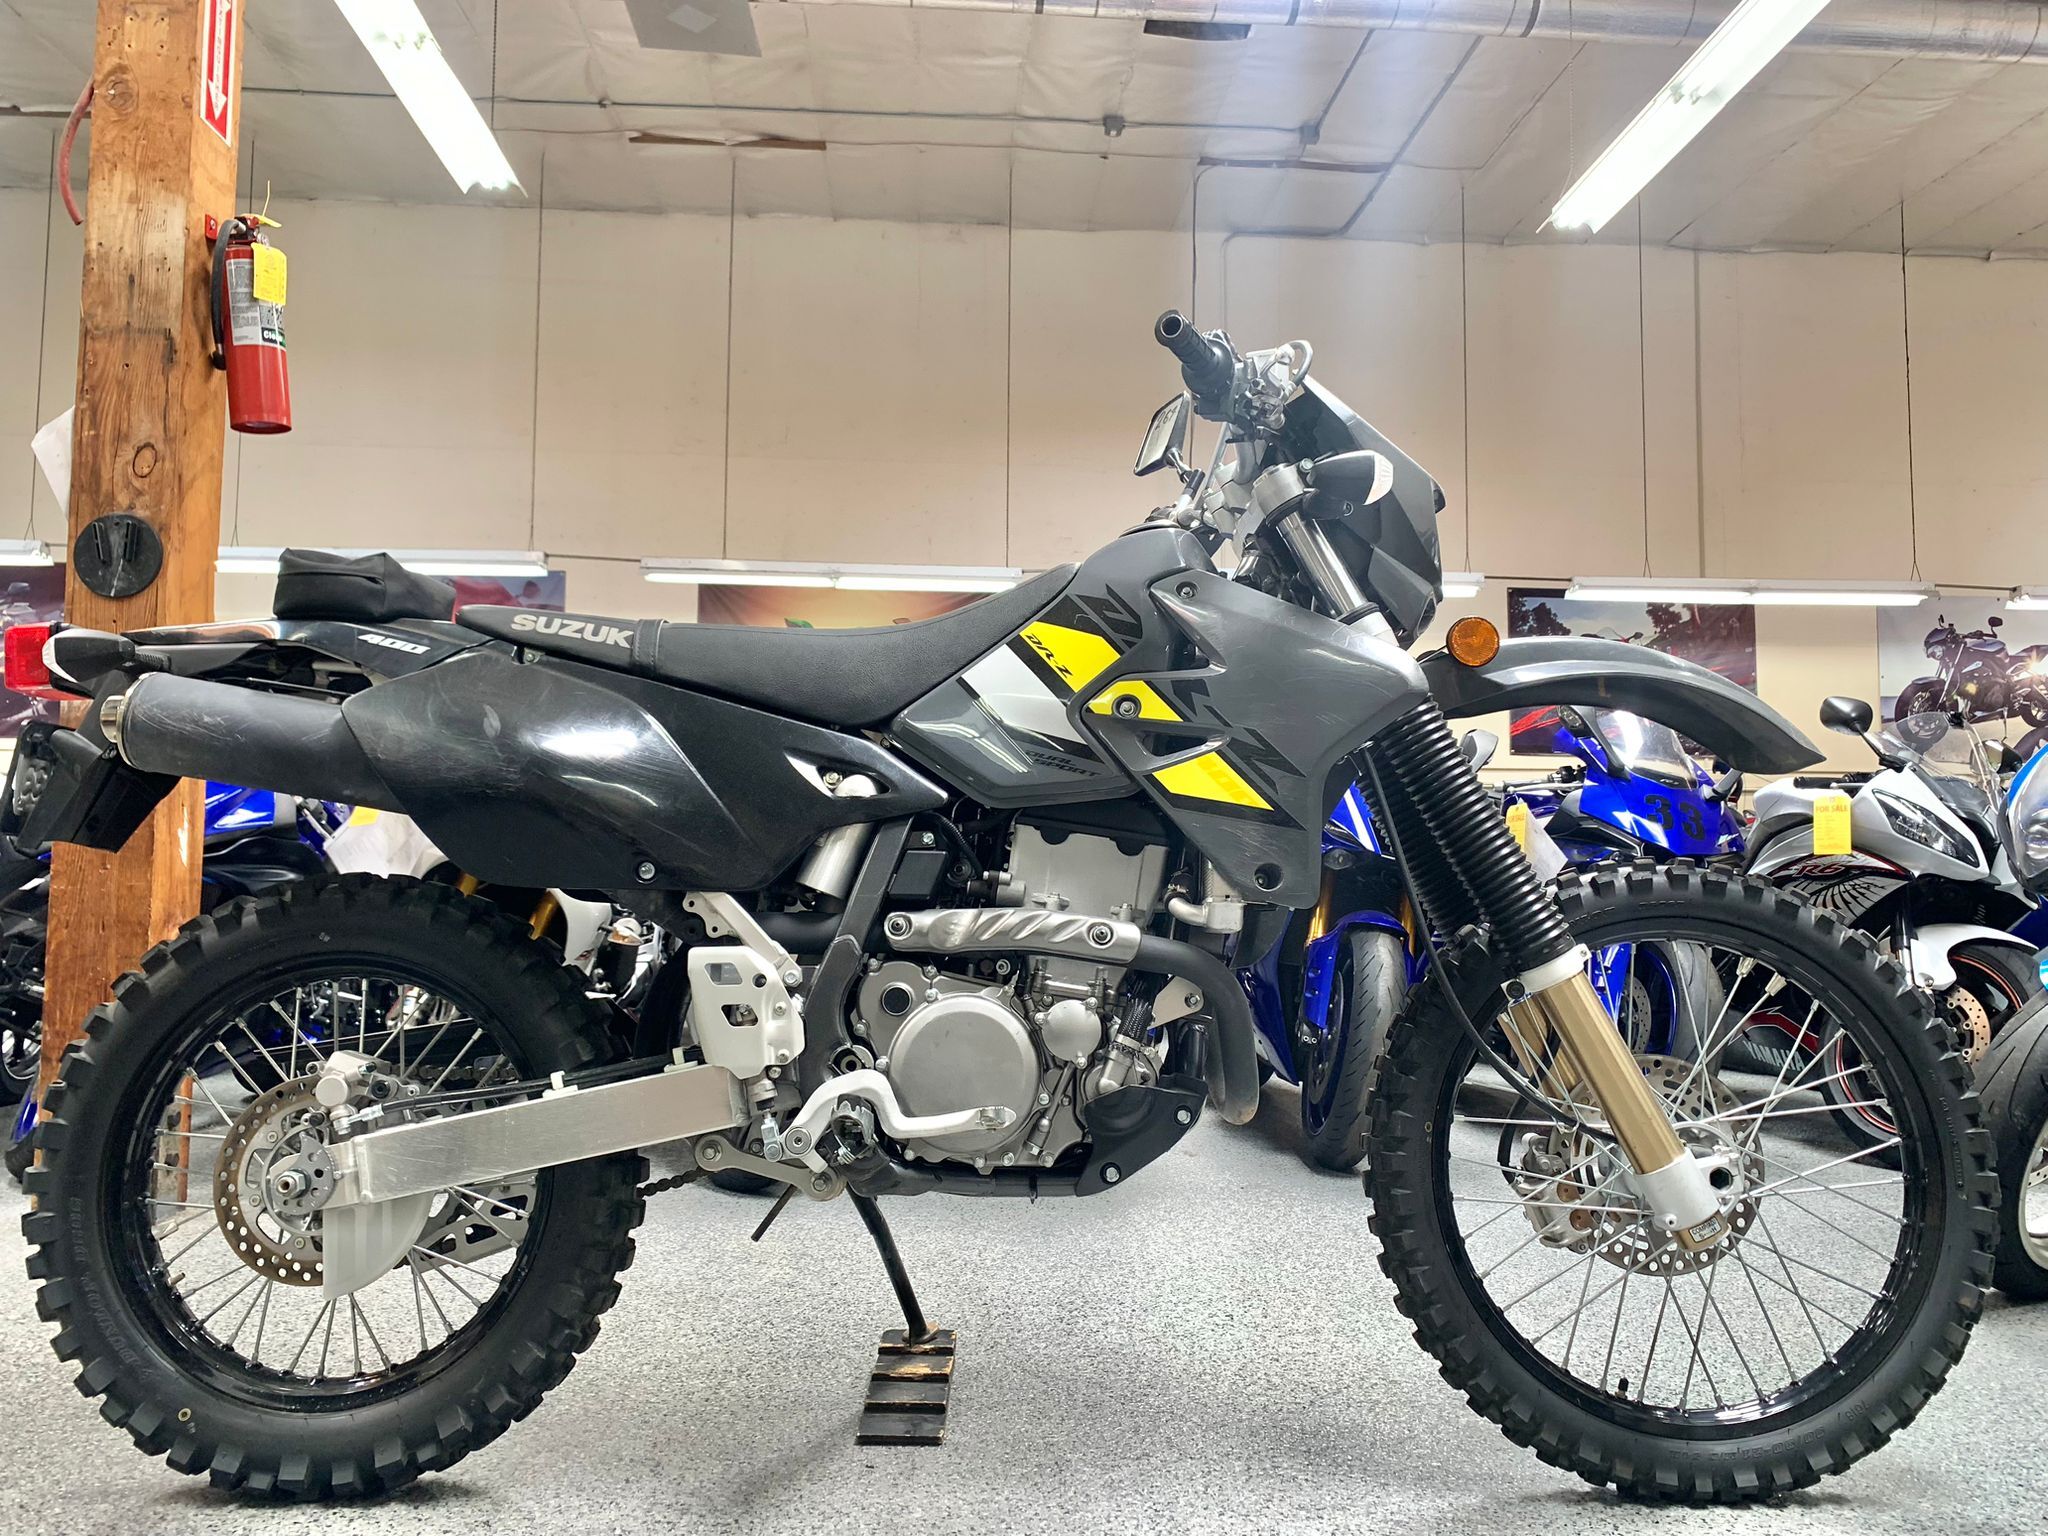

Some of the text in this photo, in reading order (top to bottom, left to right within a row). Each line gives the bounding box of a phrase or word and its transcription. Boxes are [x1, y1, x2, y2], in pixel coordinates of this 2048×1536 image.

[358, 633, 431, 655] 400
[511, 614, 635, 649] SUZUK
[1025, 633, 1074, 679] DR-Z
[1033, 758, 1102, 777] SPORT
[1645, 794, 1705, 840] 33
[1816, 804, 1849, 813] FOR SALE
[1794, 863, 1846, 878] R6
[1742, 1040, 1806, 1072] YAMAHA
